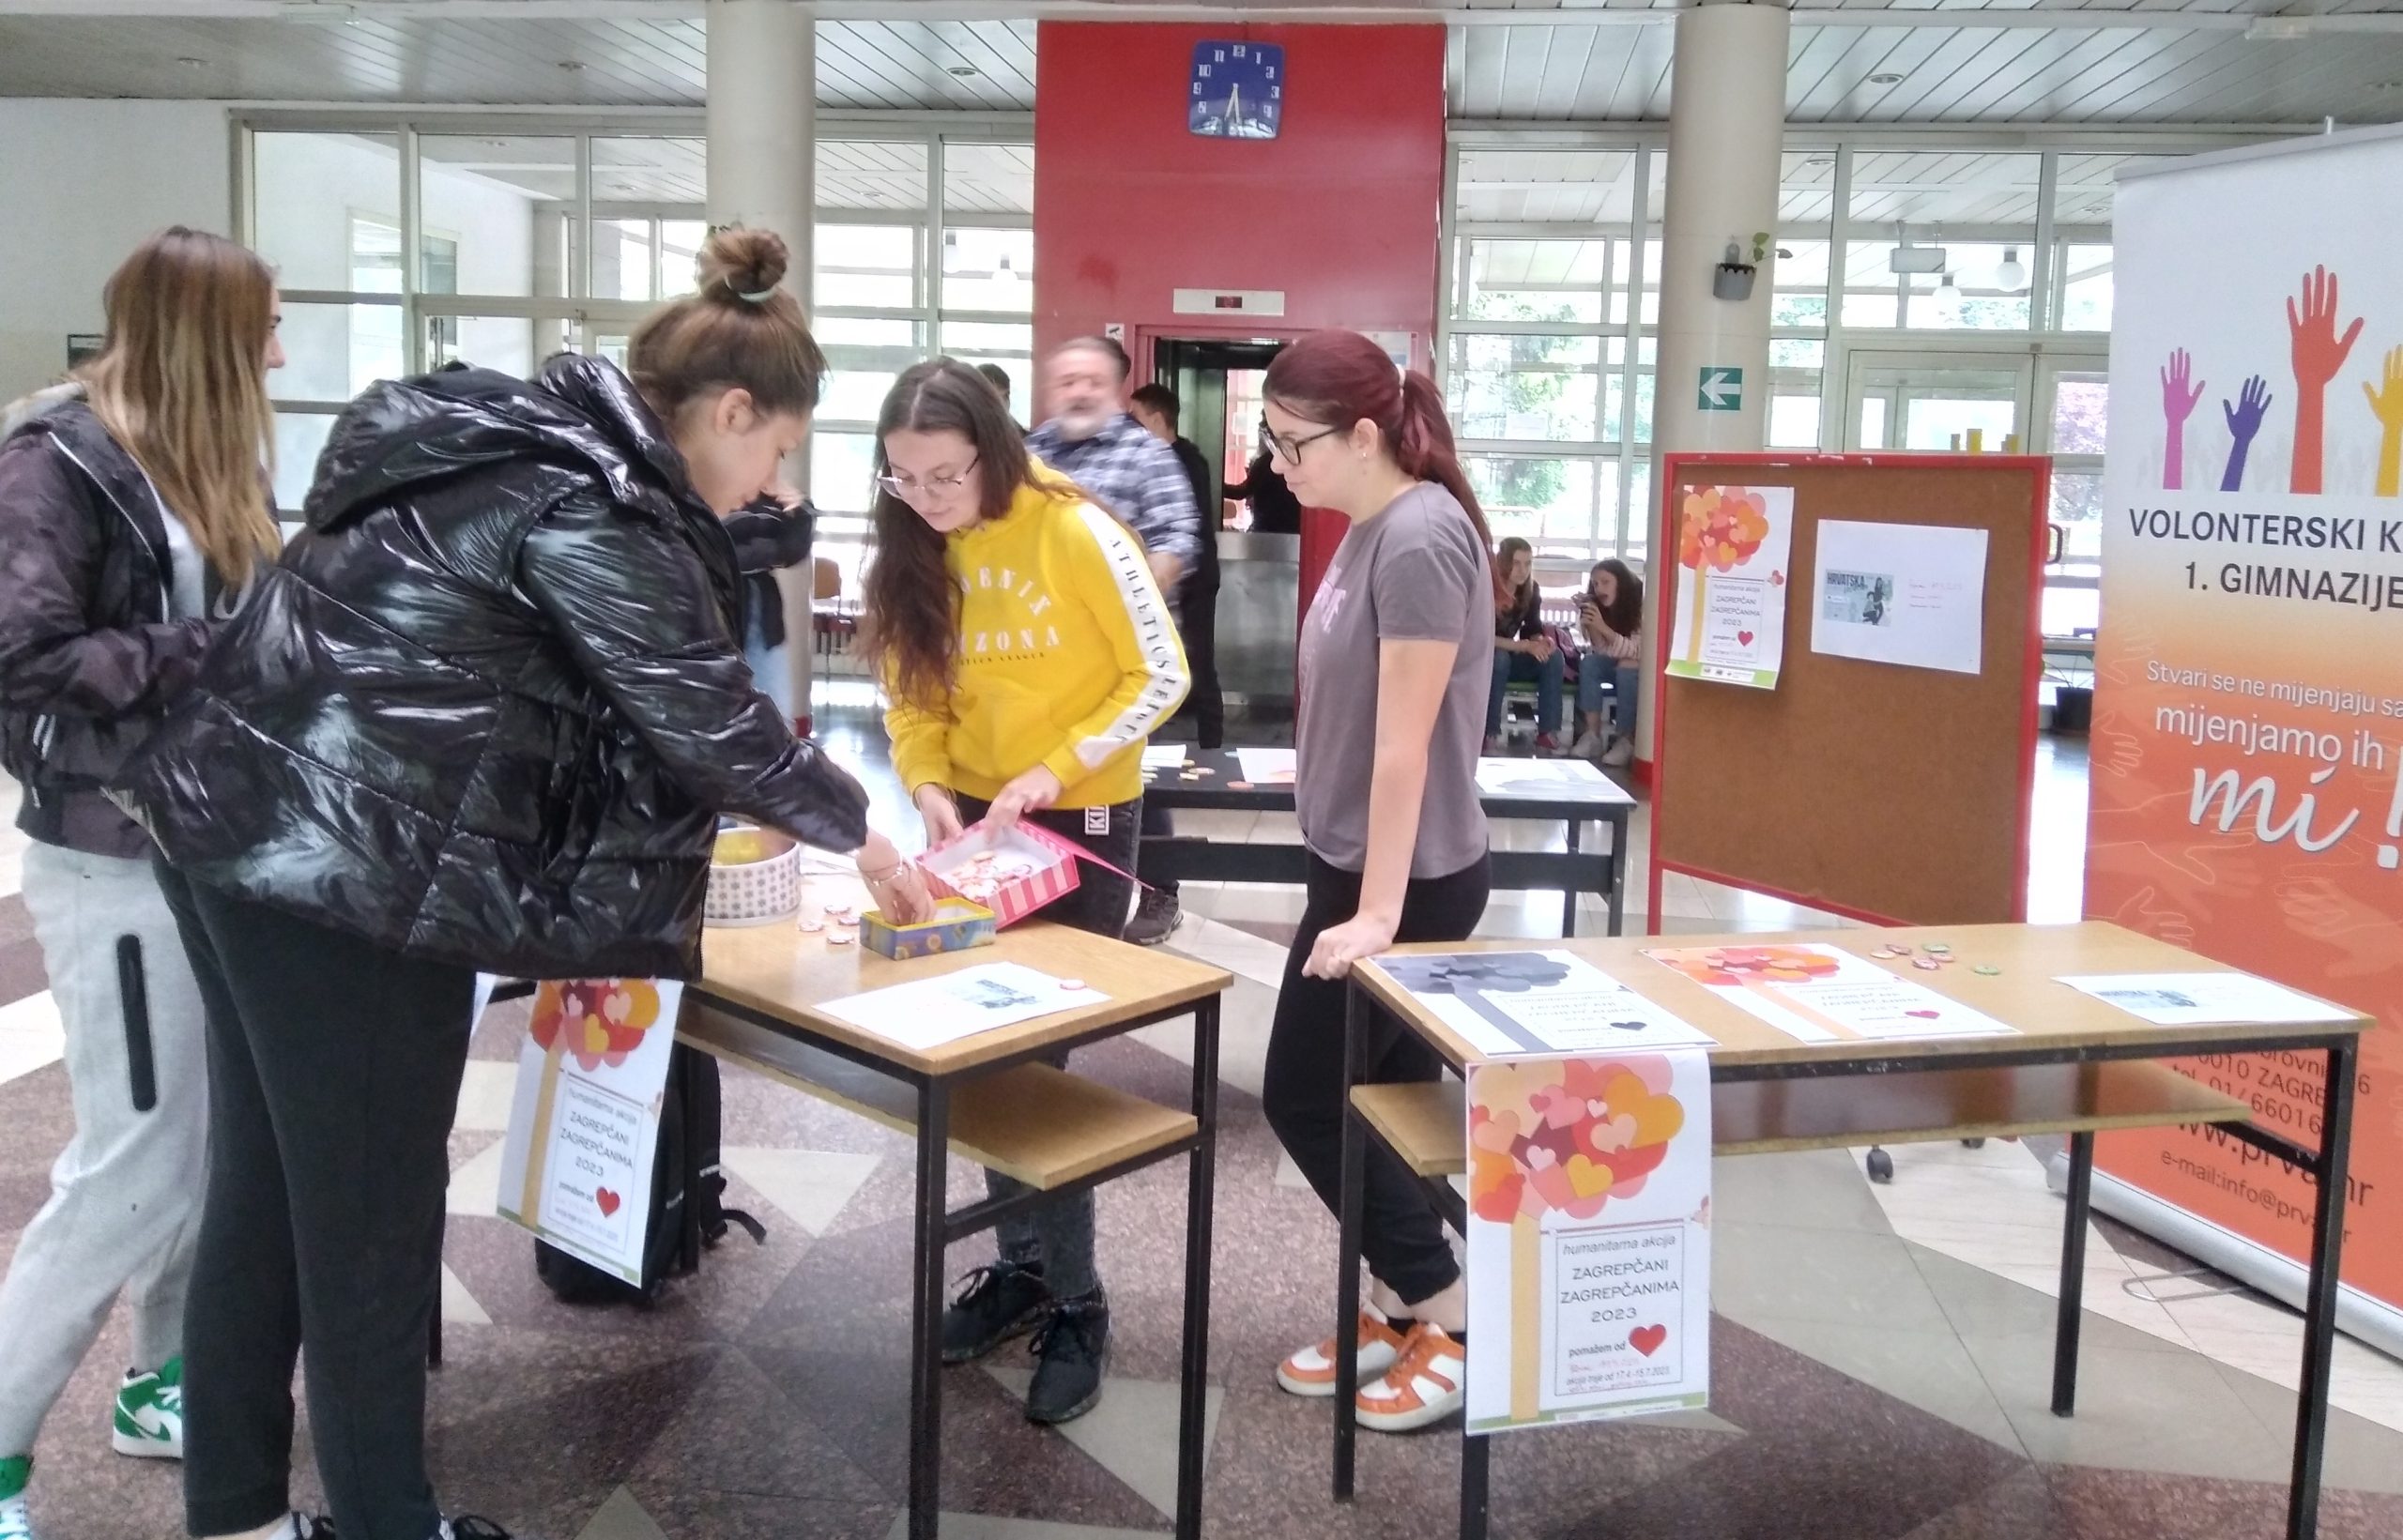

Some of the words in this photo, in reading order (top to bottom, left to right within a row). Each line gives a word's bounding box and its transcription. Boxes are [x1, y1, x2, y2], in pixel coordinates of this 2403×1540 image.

[2129, 508, 2365, 550] VOLONTERSKI
[1110, 539, 1171, 670] ATHLETICS
[2185, 561, 2209, 591] 1.
[2220, 562, 2403, 612] GIMNAZIJE
[2147, 661, 2208, 690] Stvari
[2212, 672, 2235, 693] se
[2240, 679, 2266, 698] ne
[2270, 680, 2377, 716] mijenjaju
[2155, 704, 2342, 763] mijenjamo
[2352, 729, 2383, 770] ih
[2257, 1067, 2326, 1107] ZAGRE
[1572, 1257, 1669, 1280] ZAGREPČANI
[1560, 1281, 1680, 1304] ZAGREPČANIMA
[1590, 1307, 1638, 1323] 2023
